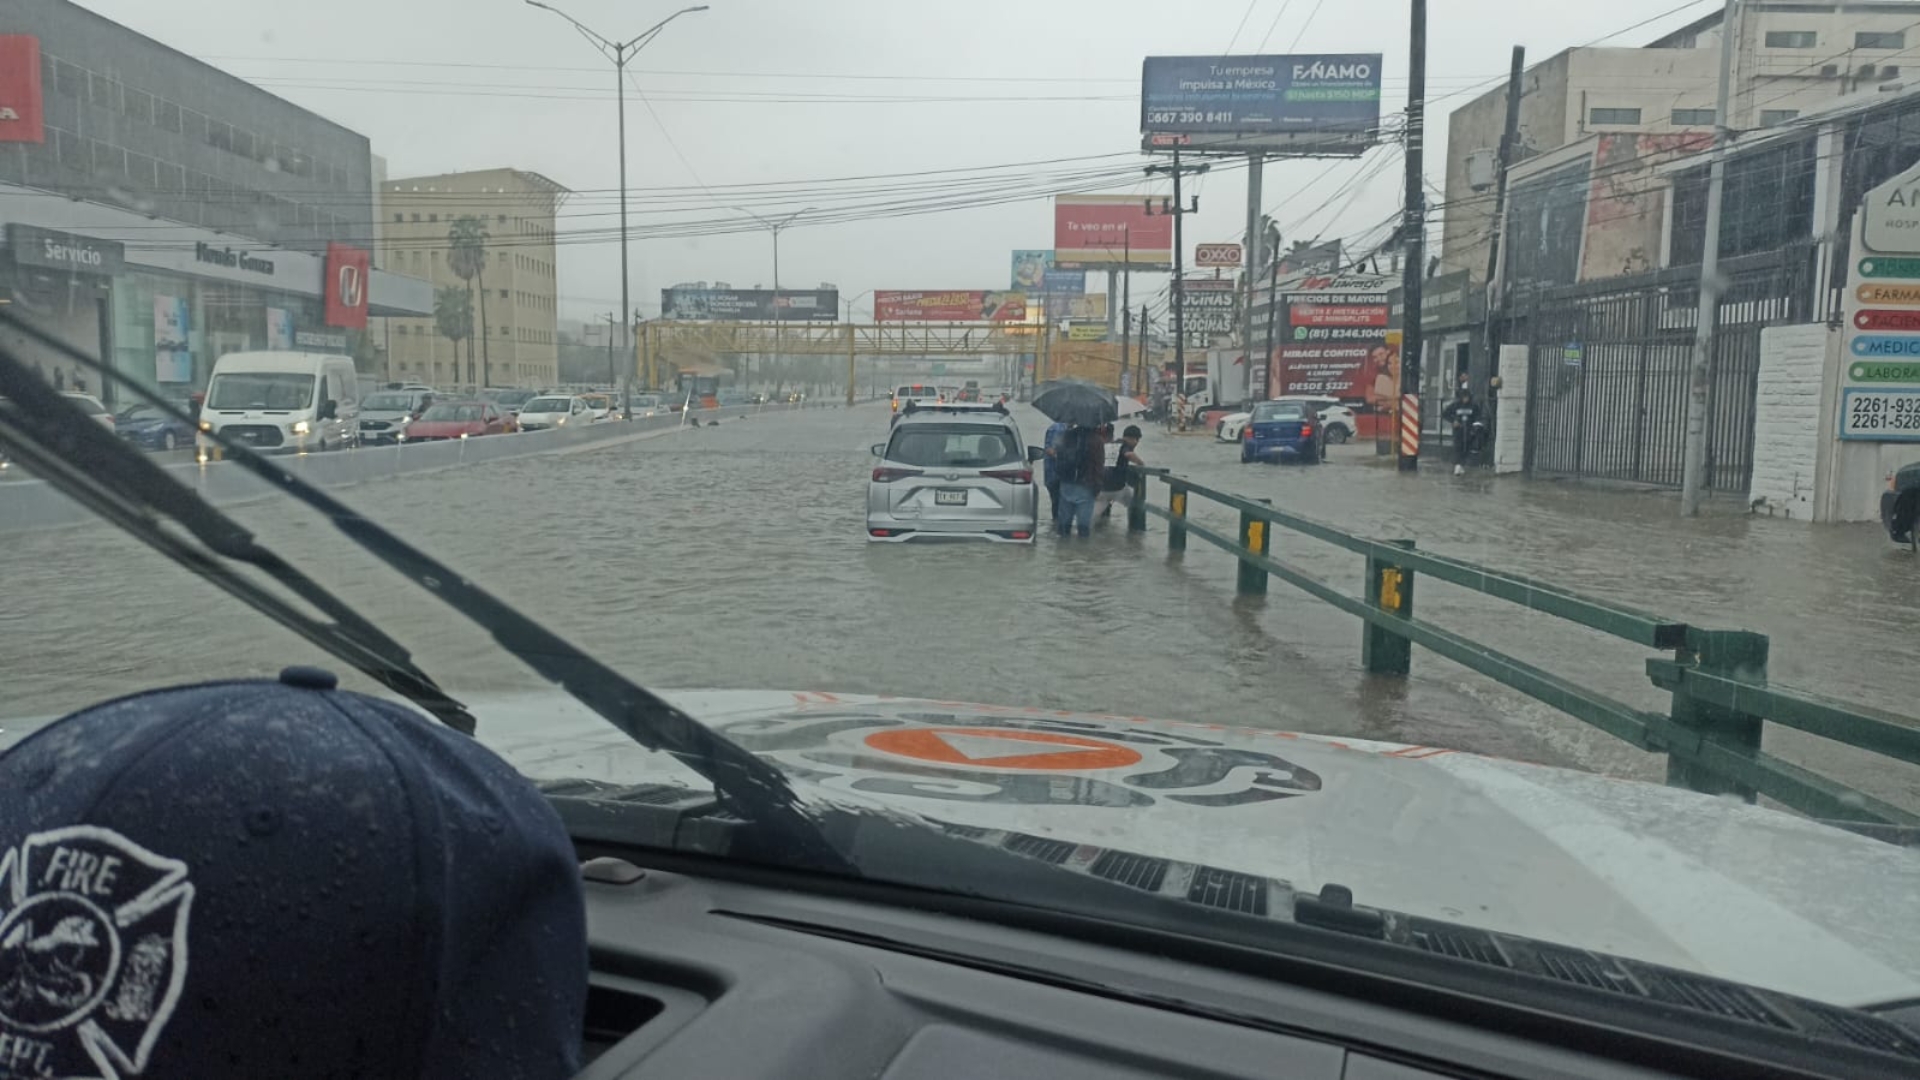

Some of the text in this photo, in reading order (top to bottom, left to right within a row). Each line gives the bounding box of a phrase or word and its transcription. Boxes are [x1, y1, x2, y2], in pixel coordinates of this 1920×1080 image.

[1210, 65, 1274, 78] Tu empresa
[1179, 112, 1203, 124] 390
[1206, 112, 1232, 124] 8411
[1067, 221, 1127, 231] Te veo en el
[44, 238, 101, 265] Servicio
[1199, 249, 1240, 261] OXXO
[1287, 294, 1330, 304] PRECIOS
[1332, 294, 1345, 304] DE
[1309, 328, 1329, 339] (81)
[1868, 341, 1920, 353] MEDIC
[1283, 349, 1367, 358] MIRAGE CONTIGO
[1289, 382, 1322, 390] DESDE
[1853, 397, 1920, 413] 2261-932
[1852, 413, 1920, 429] 2261-528
[45, 846, 121, 895] FIRE
